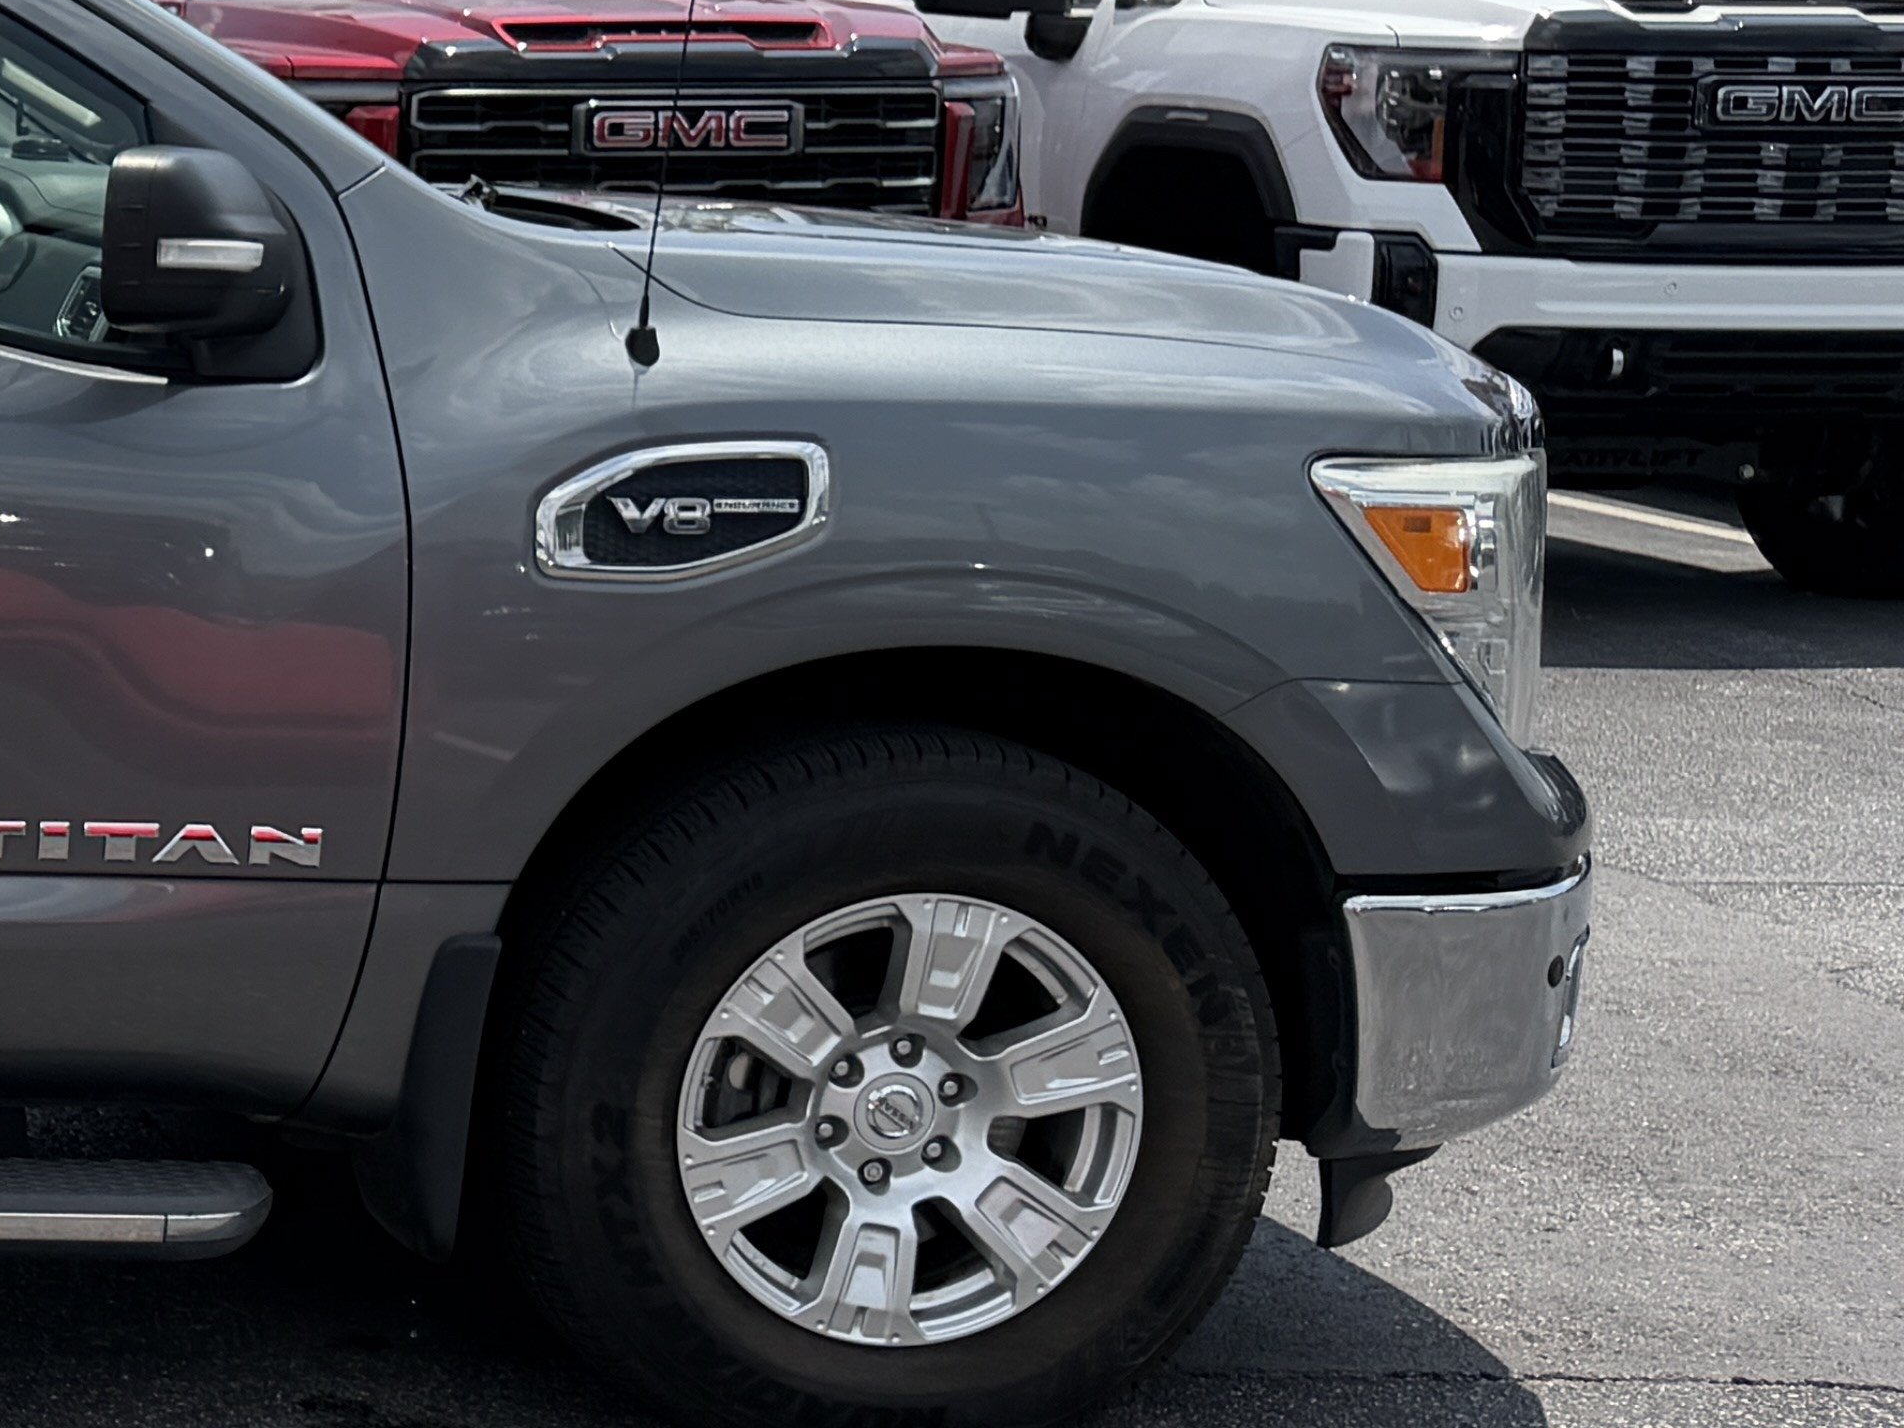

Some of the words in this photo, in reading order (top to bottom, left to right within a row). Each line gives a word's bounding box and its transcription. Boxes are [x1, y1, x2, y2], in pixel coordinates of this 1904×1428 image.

[1716, 85, 1904, 122] GMC
[591, 108, 792, 150] GMC
[606, 496, 712, 535] V8
[1024, 821, 1235, 1028] NEXEN
